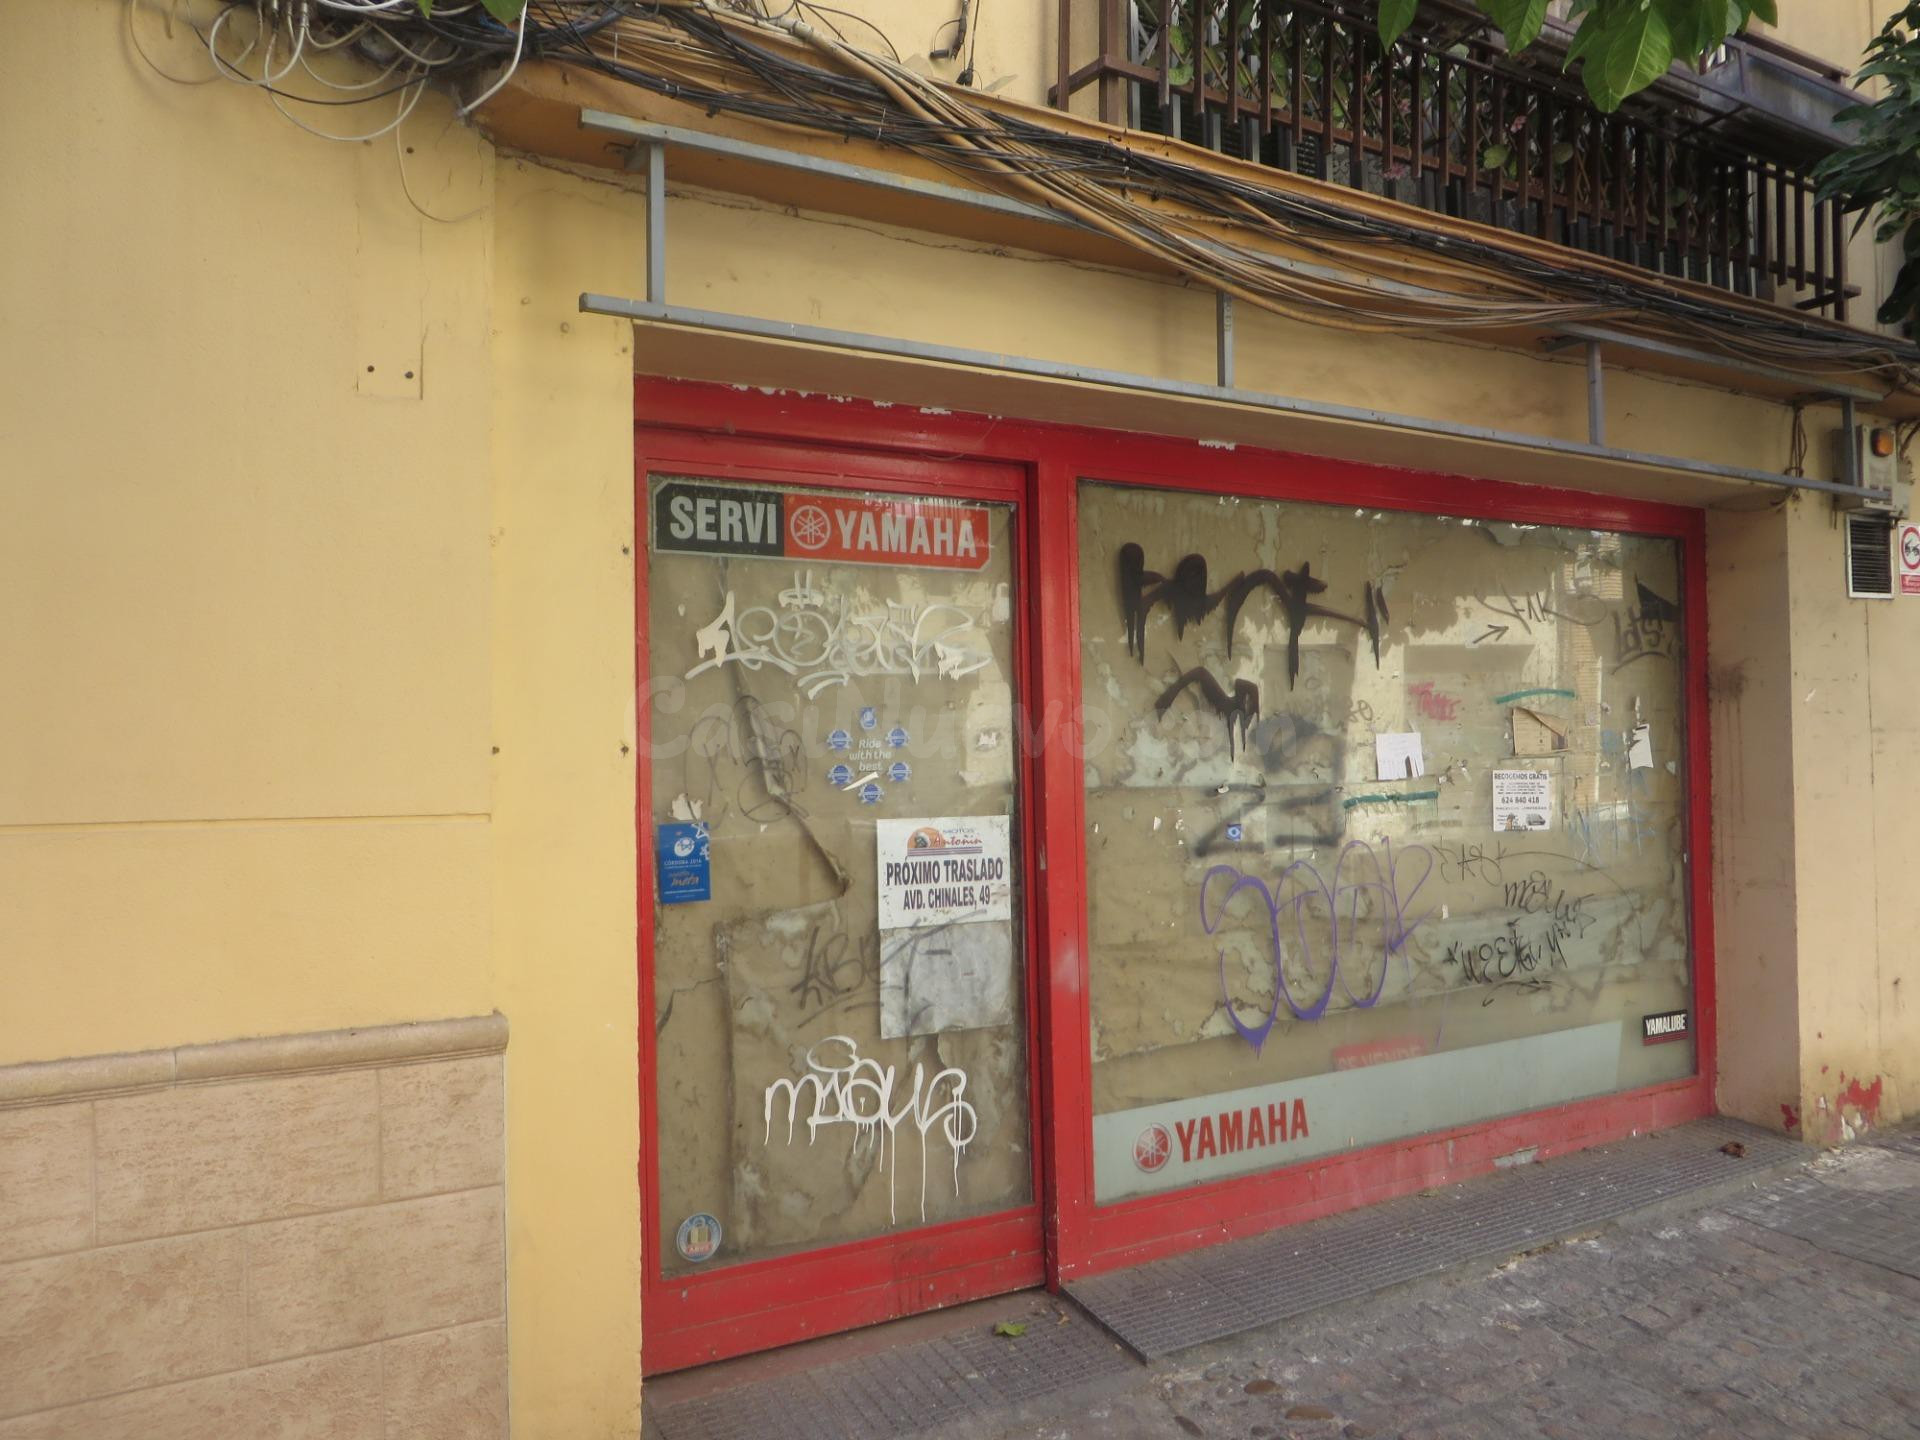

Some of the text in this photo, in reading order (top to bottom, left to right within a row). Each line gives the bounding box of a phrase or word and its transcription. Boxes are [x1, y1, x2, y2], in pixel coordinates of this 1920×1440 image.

[670, 496, 977, 558] SERVI YAMAHA
[859, 738, 881, 749] Ride
[943, 857, 1004, 883] TRASLADO
[903, 889, 926, 910] AVD.
[979, 885, 991, 905] 49
[1645, 1013, 1687, 1036] YAMALUBE
[1175, 1098, 1310, 1163] YAMAHA
